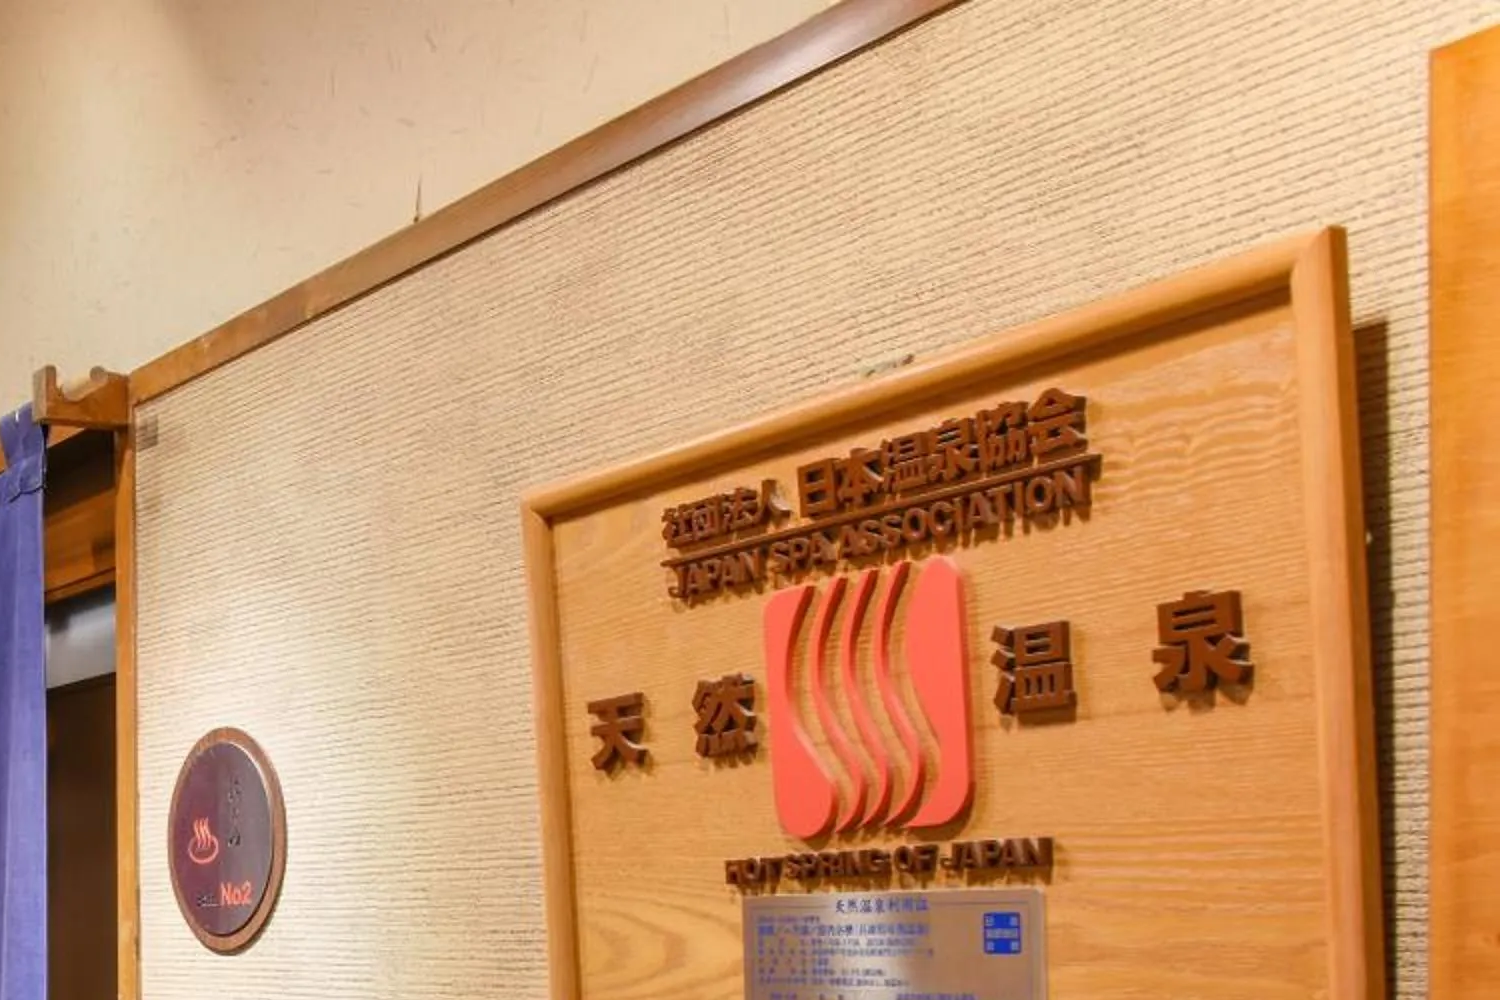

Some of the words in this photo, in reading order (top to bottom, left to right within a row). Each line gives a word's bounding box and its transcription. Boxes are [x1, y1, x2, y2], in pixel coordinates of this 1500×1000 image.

[797, 387, 1089, 518] 日本温泉協会
[668, 549, 765, 599] JAPAN
[772, 531, 837, 574] SPA
[838, 465, 1093, 560] ASSOCIATION
[894, 844, 939, 873] OF
[940, 837, 1054, 872] JAPAN
